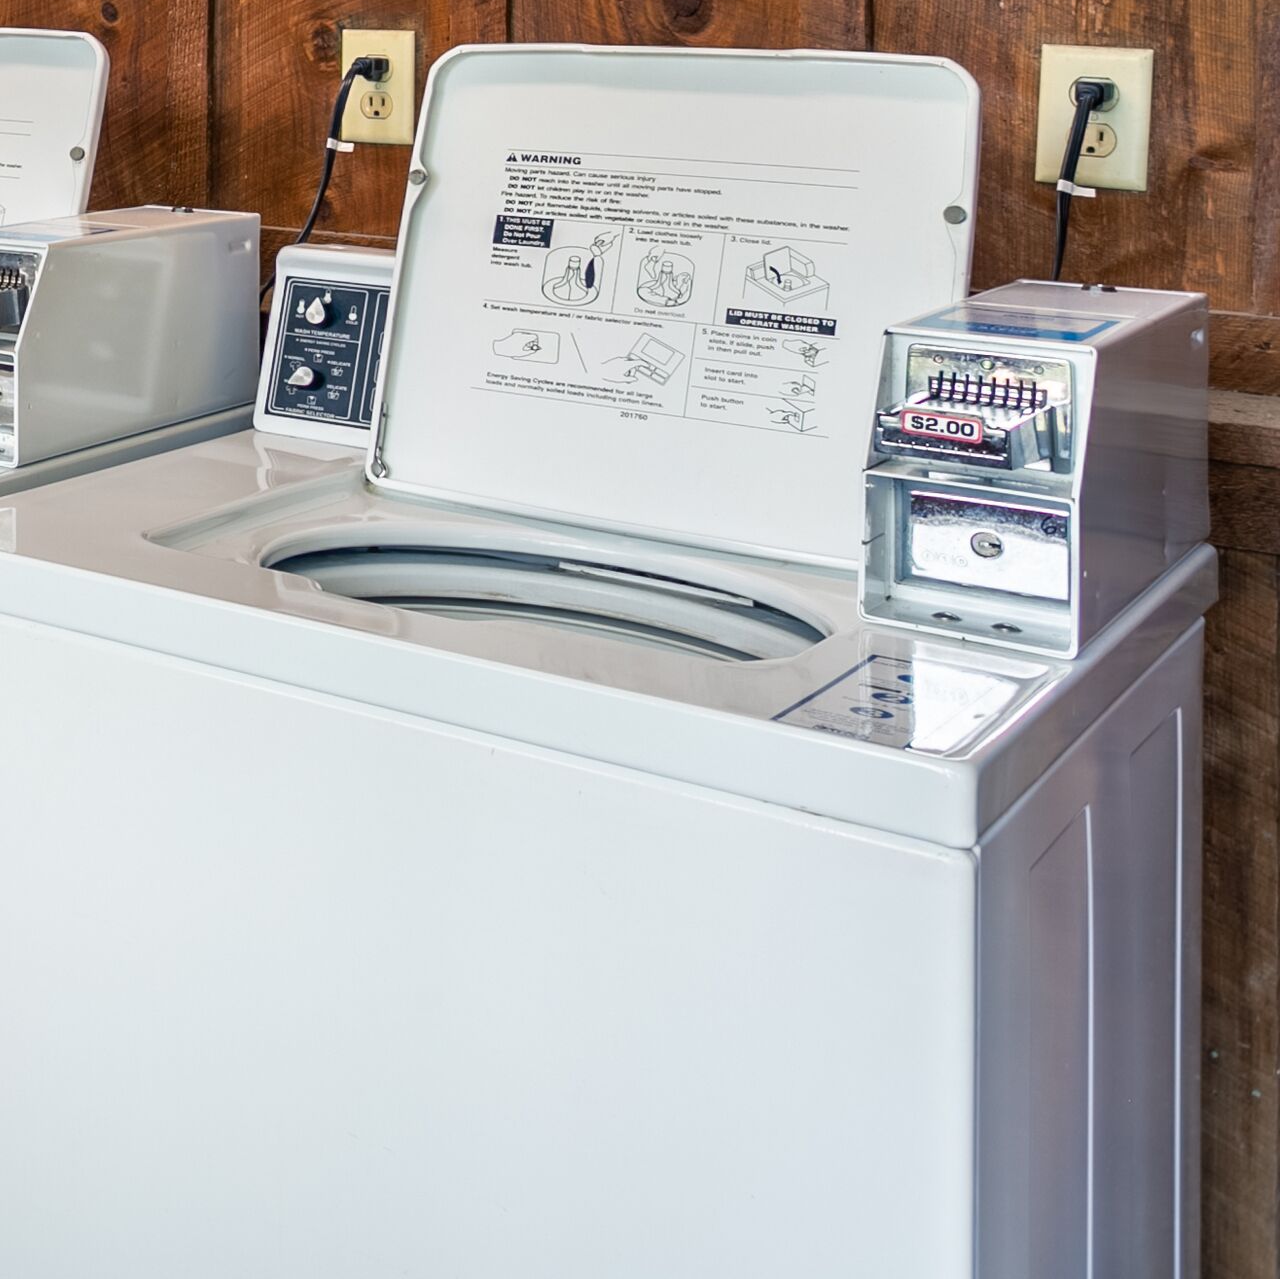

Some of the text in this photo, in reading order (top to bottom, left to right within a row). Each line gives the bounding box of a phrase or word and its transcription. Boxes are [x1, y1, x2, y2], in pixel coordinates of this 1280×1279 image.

[520, 153, 581, 165] WARNING
[728, 309, 835, 327] LID MUST BE CLOSED TO
[739, 318, 819, 333] OPERATE WASHER
[910, 415, 975, 438] $2.00
